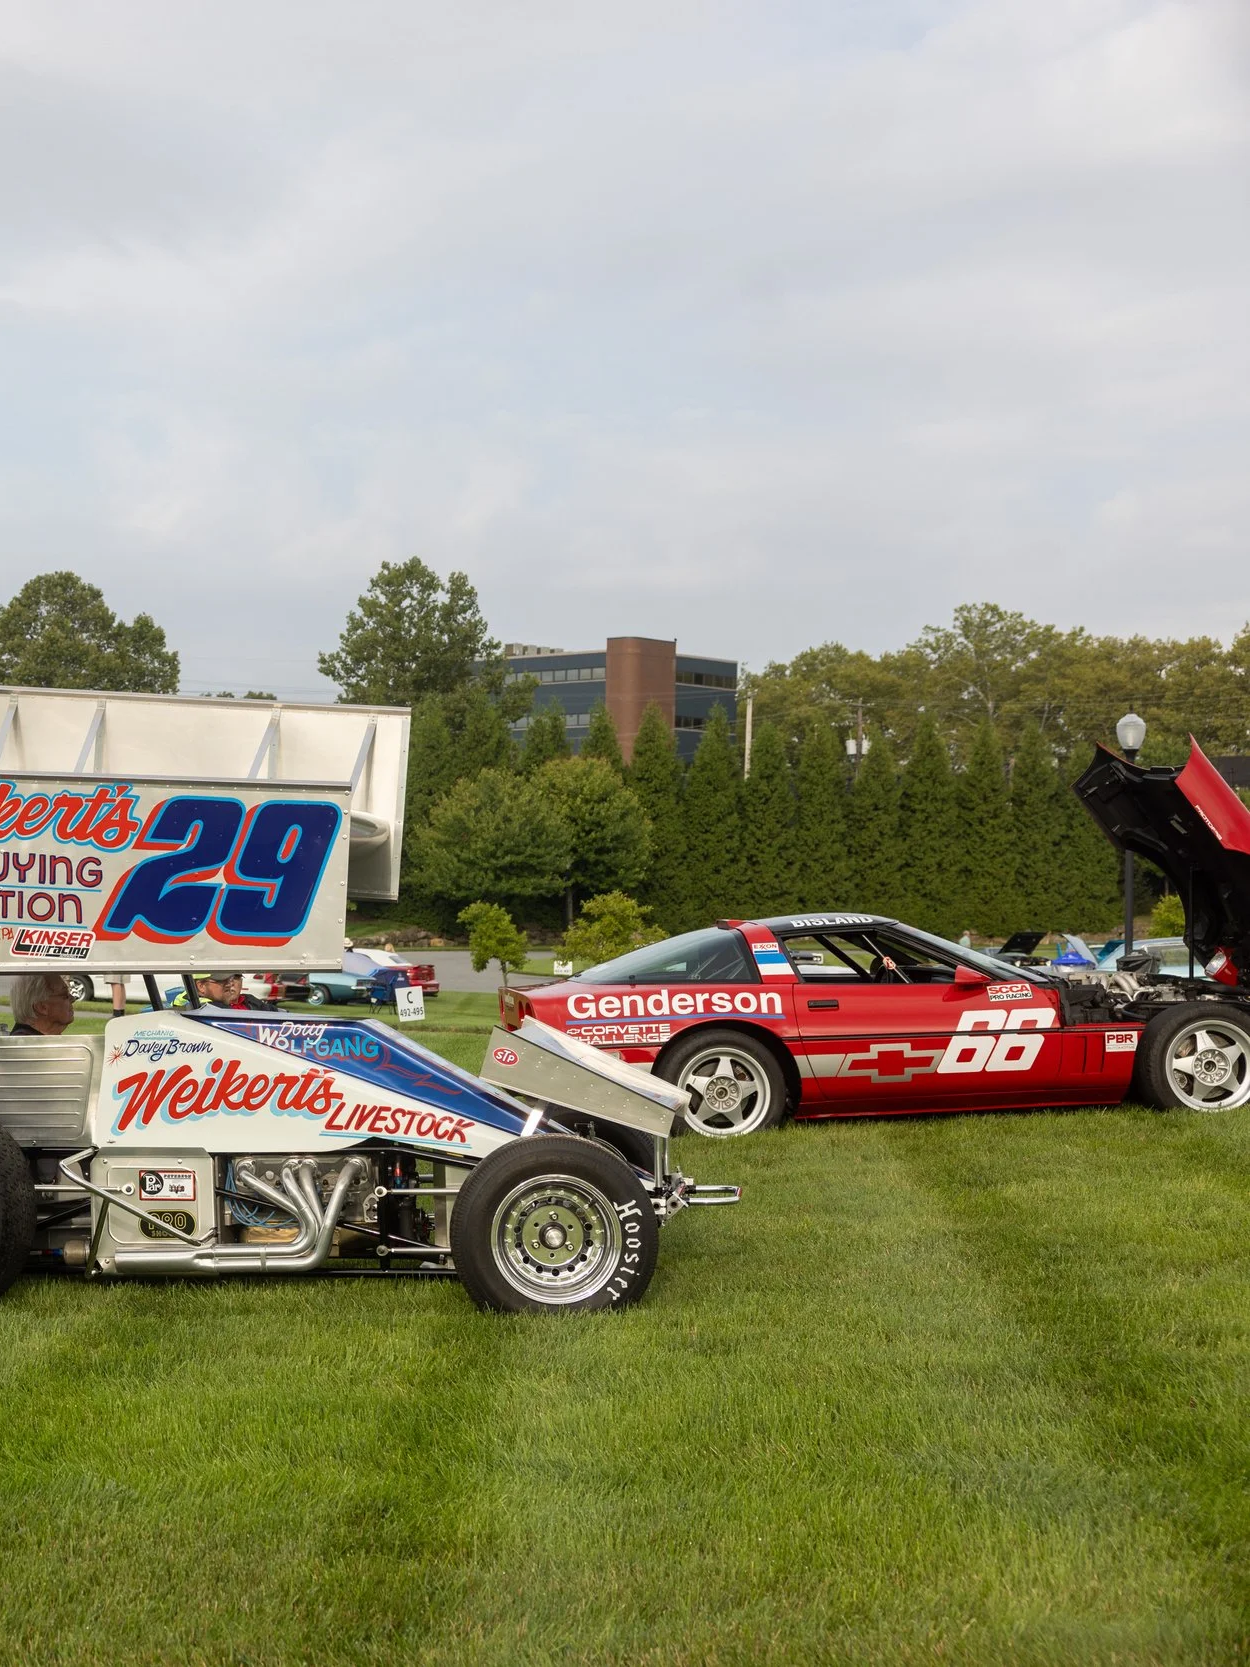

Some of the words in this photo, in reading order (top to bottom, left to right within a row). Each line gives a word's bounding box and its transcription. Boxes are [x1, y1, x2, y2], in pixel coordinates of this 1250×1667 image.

[98, 795, 343, 944] 29
[790, 916, 874, 928] BISLAND
[21, 929, 94, 948] KINSER
[753, 943, 778, 951] EXXON
[46, 946, 91, 959] racing
[406, 991, 414, 1004] C
[988, 985, 1030, 994] SCCA
[566, 989, 783, 1019] Genderson
[134, 1030, 175, 1038] MECHANIC
[279, 1021, 328, 1045] Doug
[581, 1023, 671, 1035] CORVETTE
[1107, 1034, 1134, 1043] PBR
[258, 1025, 380, 1060] WOLFGANG
[936, 1007, 1056, 1074] 66
[123, 1039, 167, 1062] Davey
[166, 1039, 214, 1055] Brown
[496, 1050, 515, 1062] STP
[113, 1058, 344, 1135] Weikert's
[325, 1101, 476, 1143] LIVESTOCK
[606, 1199, 643, 1300] Hoosier
